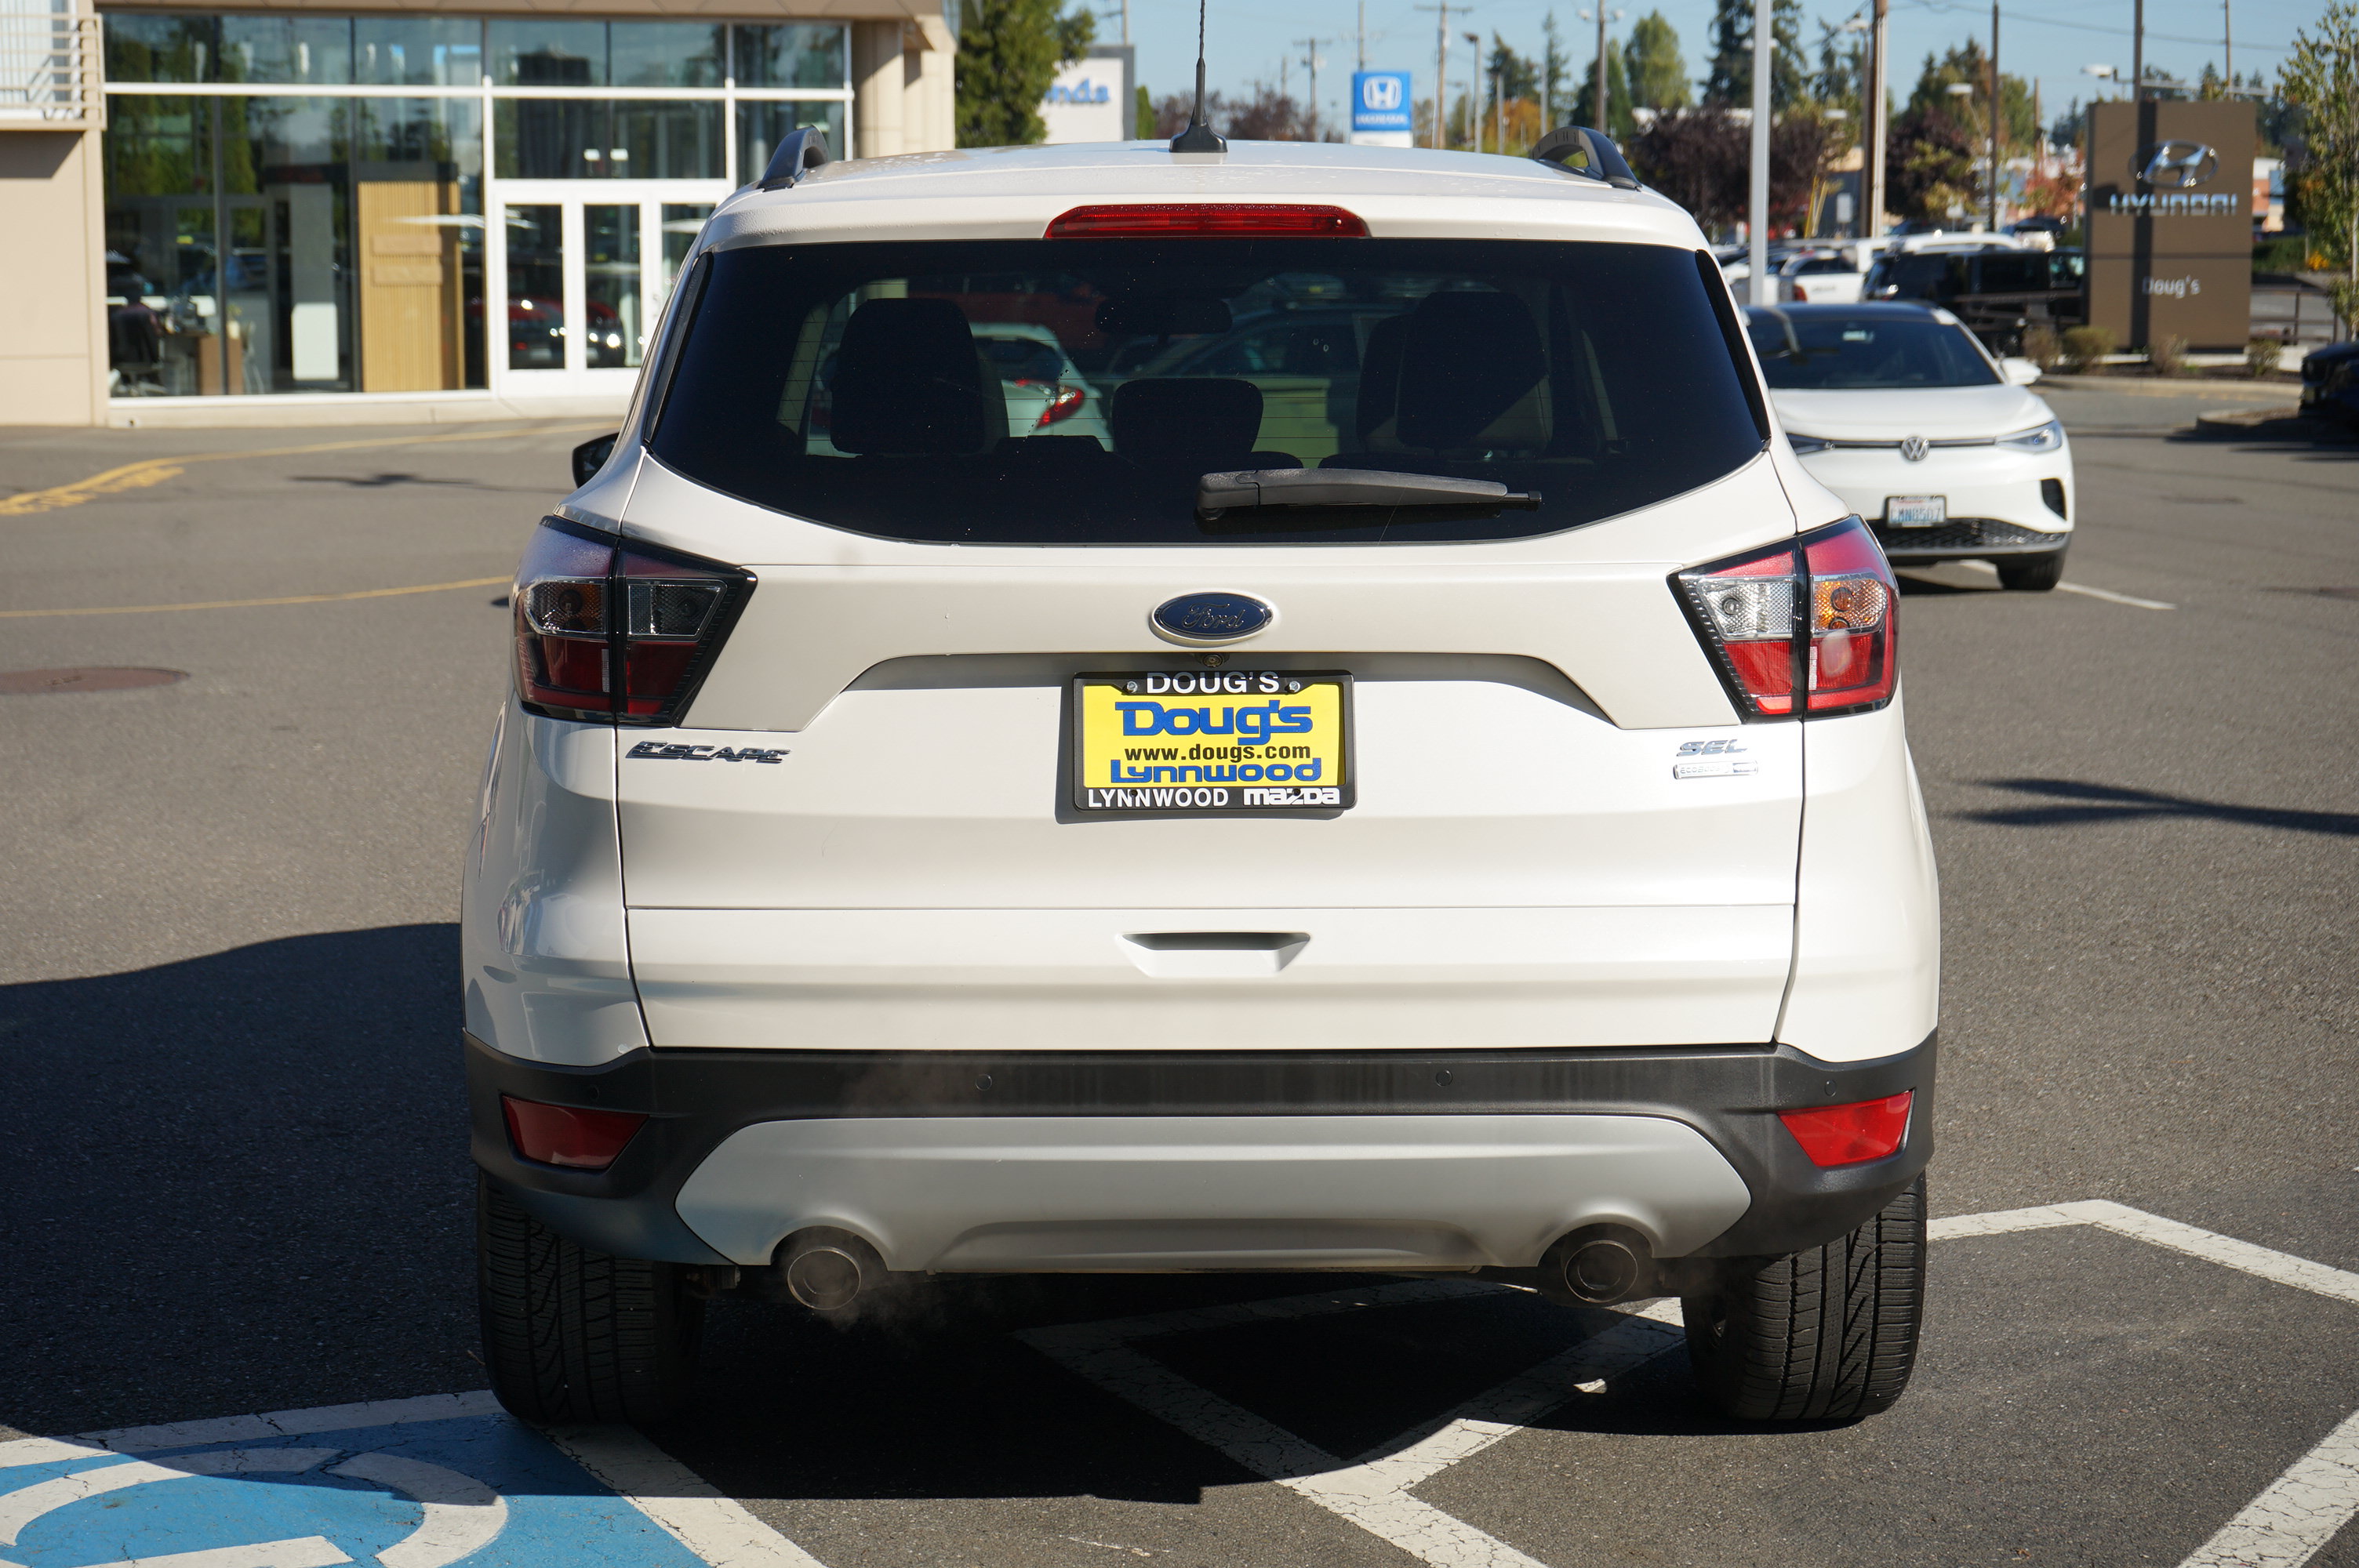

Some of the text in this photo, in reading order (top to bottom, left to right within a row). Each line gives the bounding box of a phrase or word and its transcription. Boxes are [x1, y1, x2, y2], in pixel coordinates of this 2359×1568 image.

[2110, 194, 2237, 216] HYUNDAI
[2142, 275, 2201, 299] Doug's
[1182, 602, 1246, 628] Ford
[1147, 671, 1280, 694] DOUG'S
[1114, 699, 1313, 746] Doug's
[625, 740, 791, 764] ESCAPE
[1124, 743, 1310, 763] www.dougs.com
[1676, 739, 1748, 757] SEL
[1110, 757, 1322, 783] Lynnwood
[1087, 789, 1229, 808] LYNNWOOD
